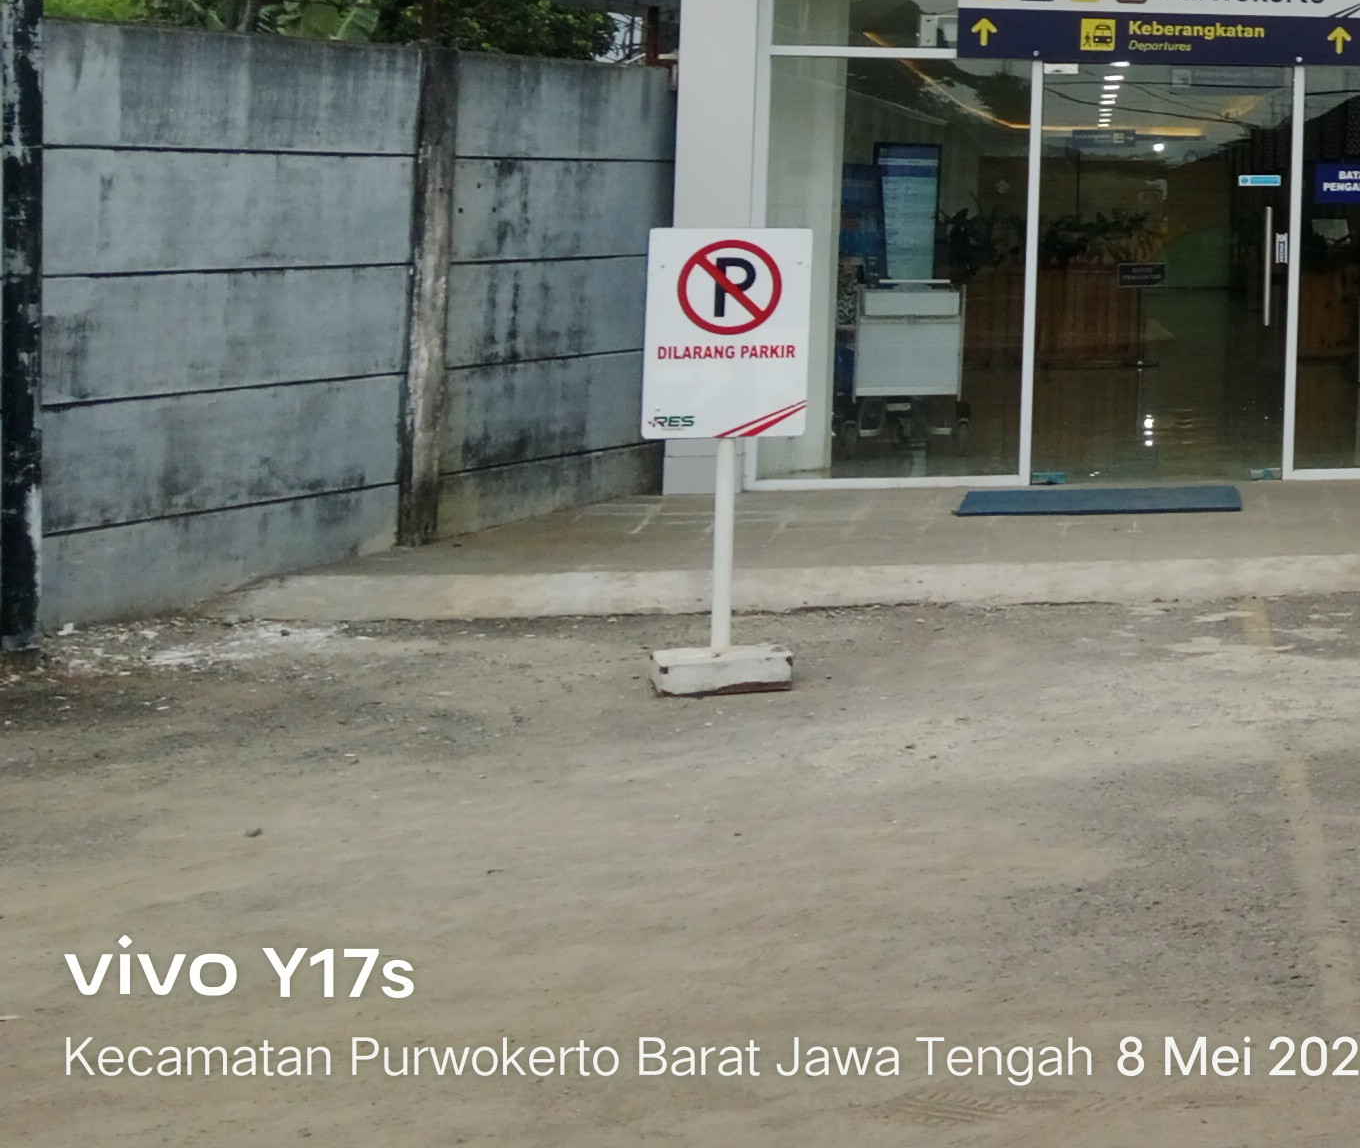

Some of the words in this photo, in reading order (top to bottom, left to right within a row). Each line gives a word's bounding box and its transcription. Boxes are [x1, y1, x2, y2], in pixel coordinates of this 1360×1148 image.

[1128, 20, 1265, 40] Keberangkatan
[1128, 40, 1192, 52] Departures
[657, 345, 736, 360] DILARANG
[740, 344, 796, 359] PARKIR
[652, 415, 695, 428] RES
